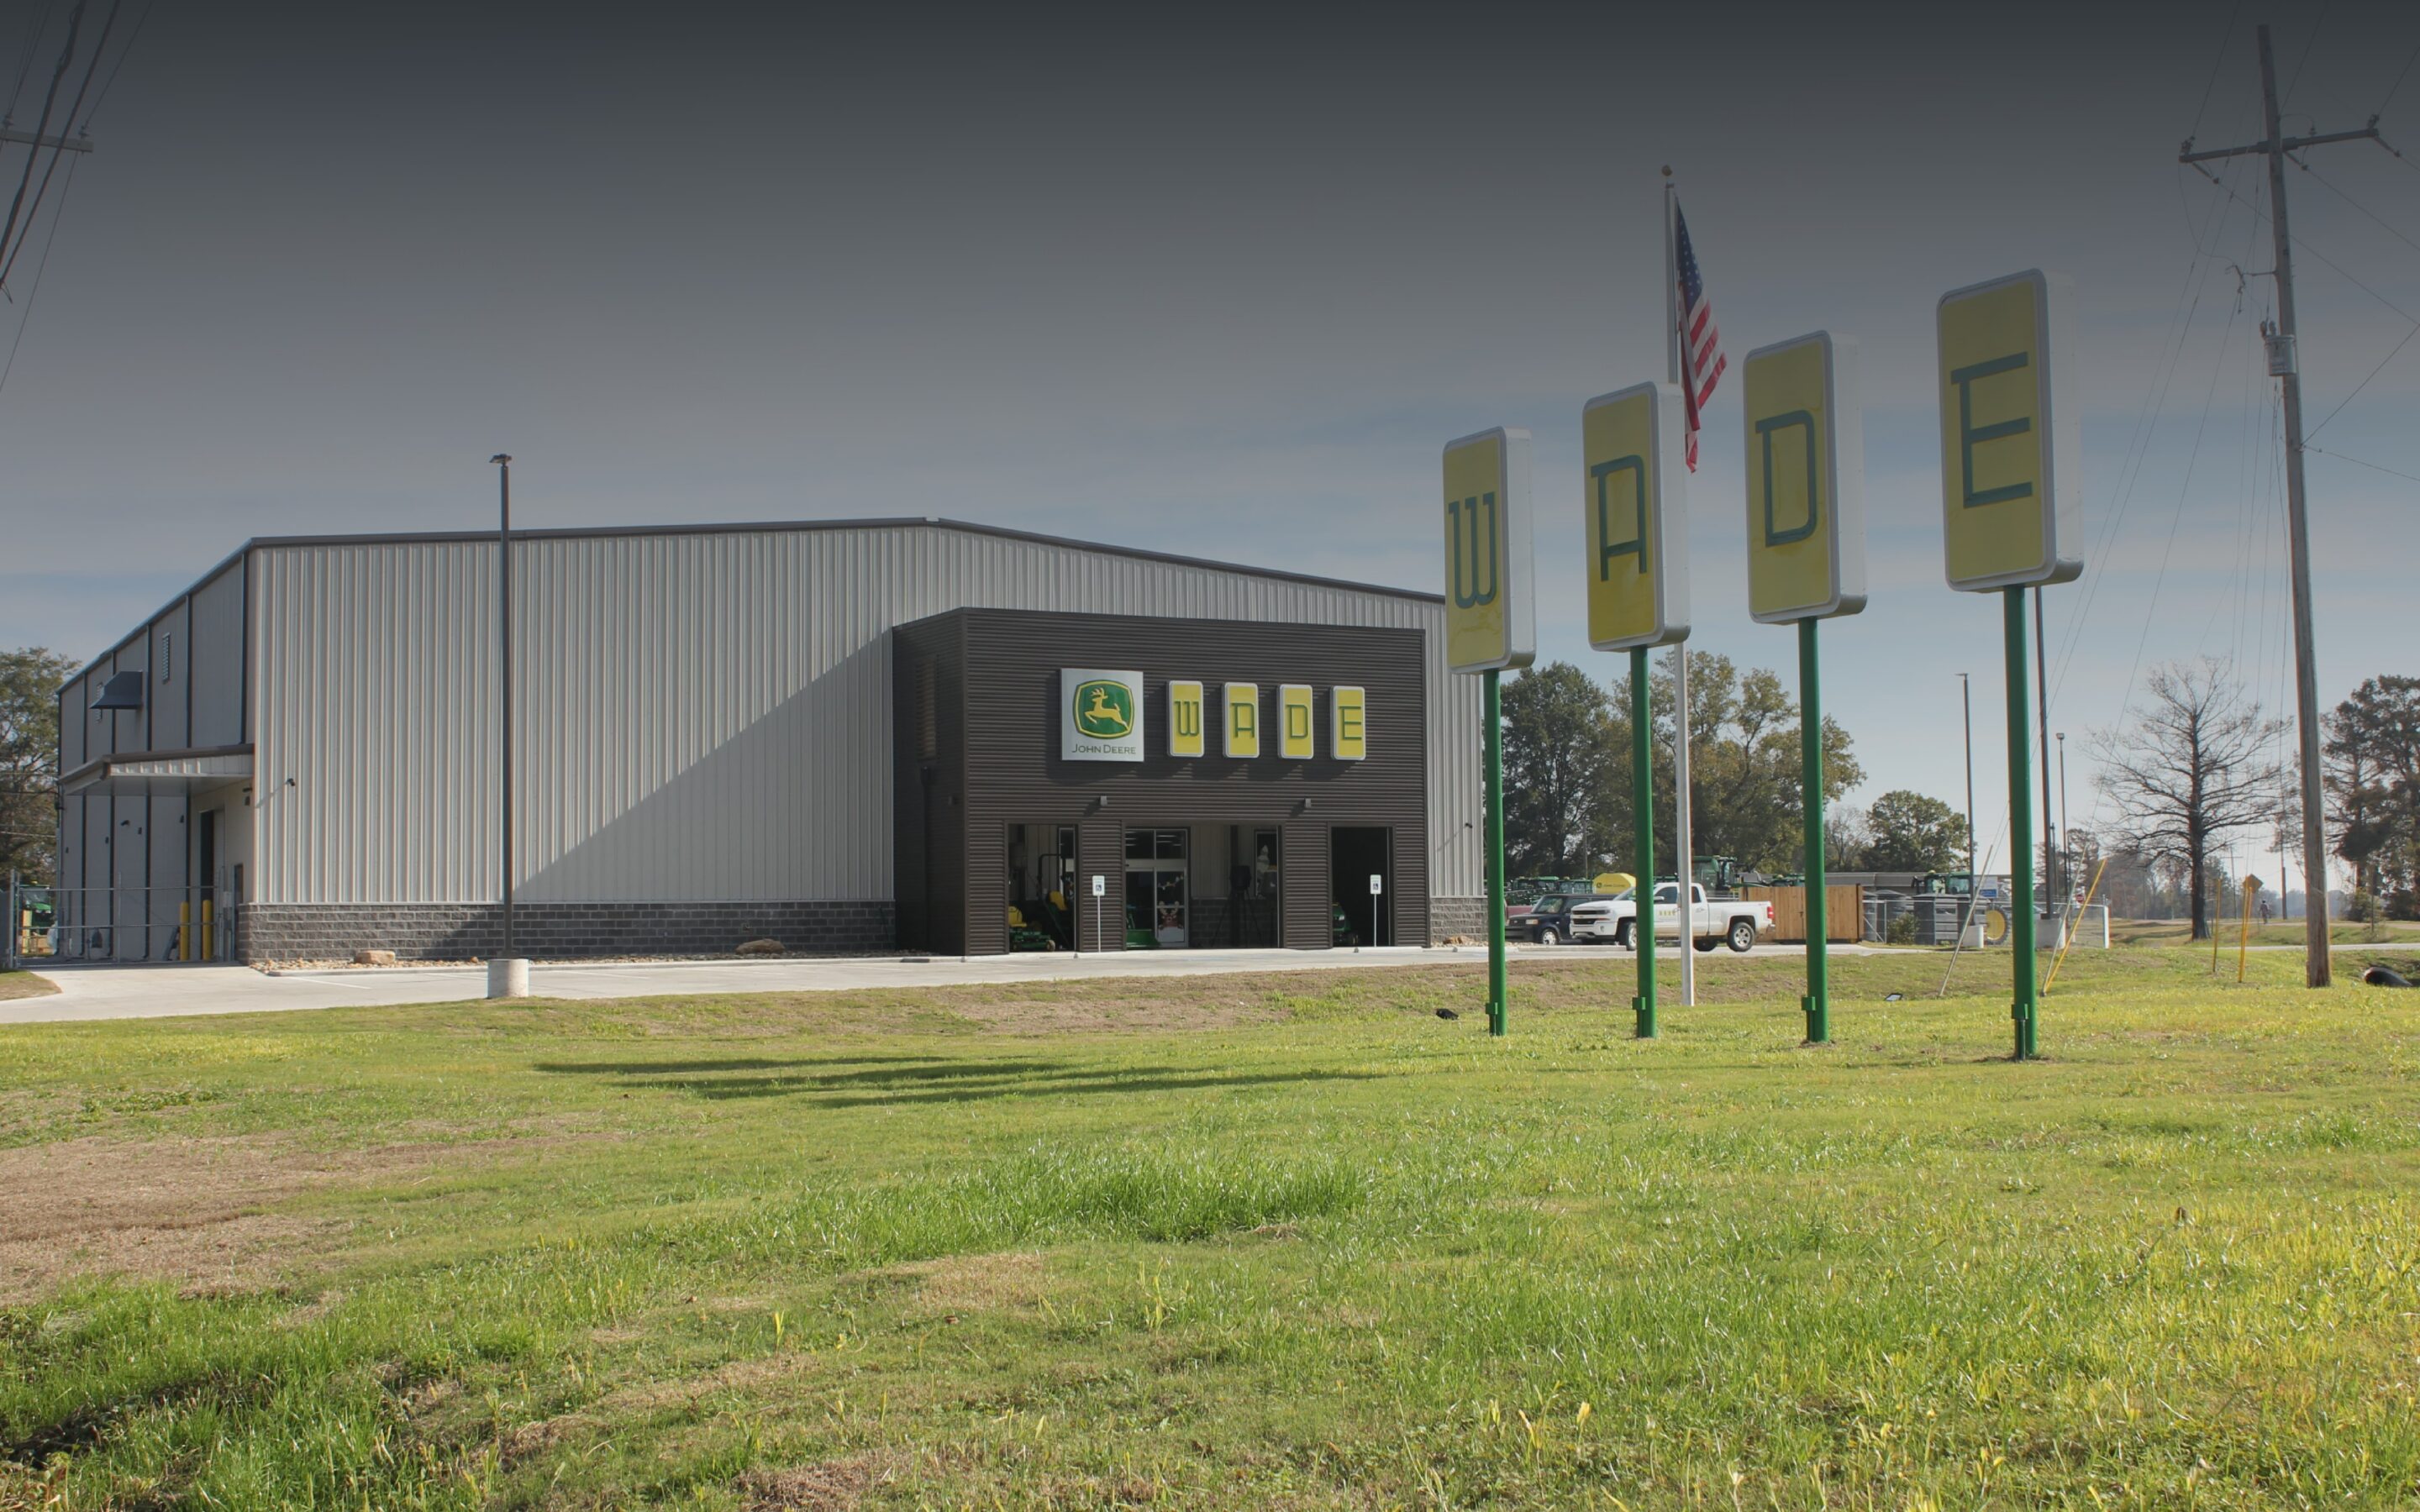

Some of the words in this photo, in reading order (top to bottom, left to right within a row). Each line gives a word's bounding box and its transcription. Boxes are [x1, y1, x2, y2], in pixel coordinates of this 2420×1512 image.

[1448, 351, 2033, 609] WADE
[1174, 701, 1362, 740] WADE
[1071, 743, 1102, 753] JOHN
[1103, 744, 1136, 754] DEERE
